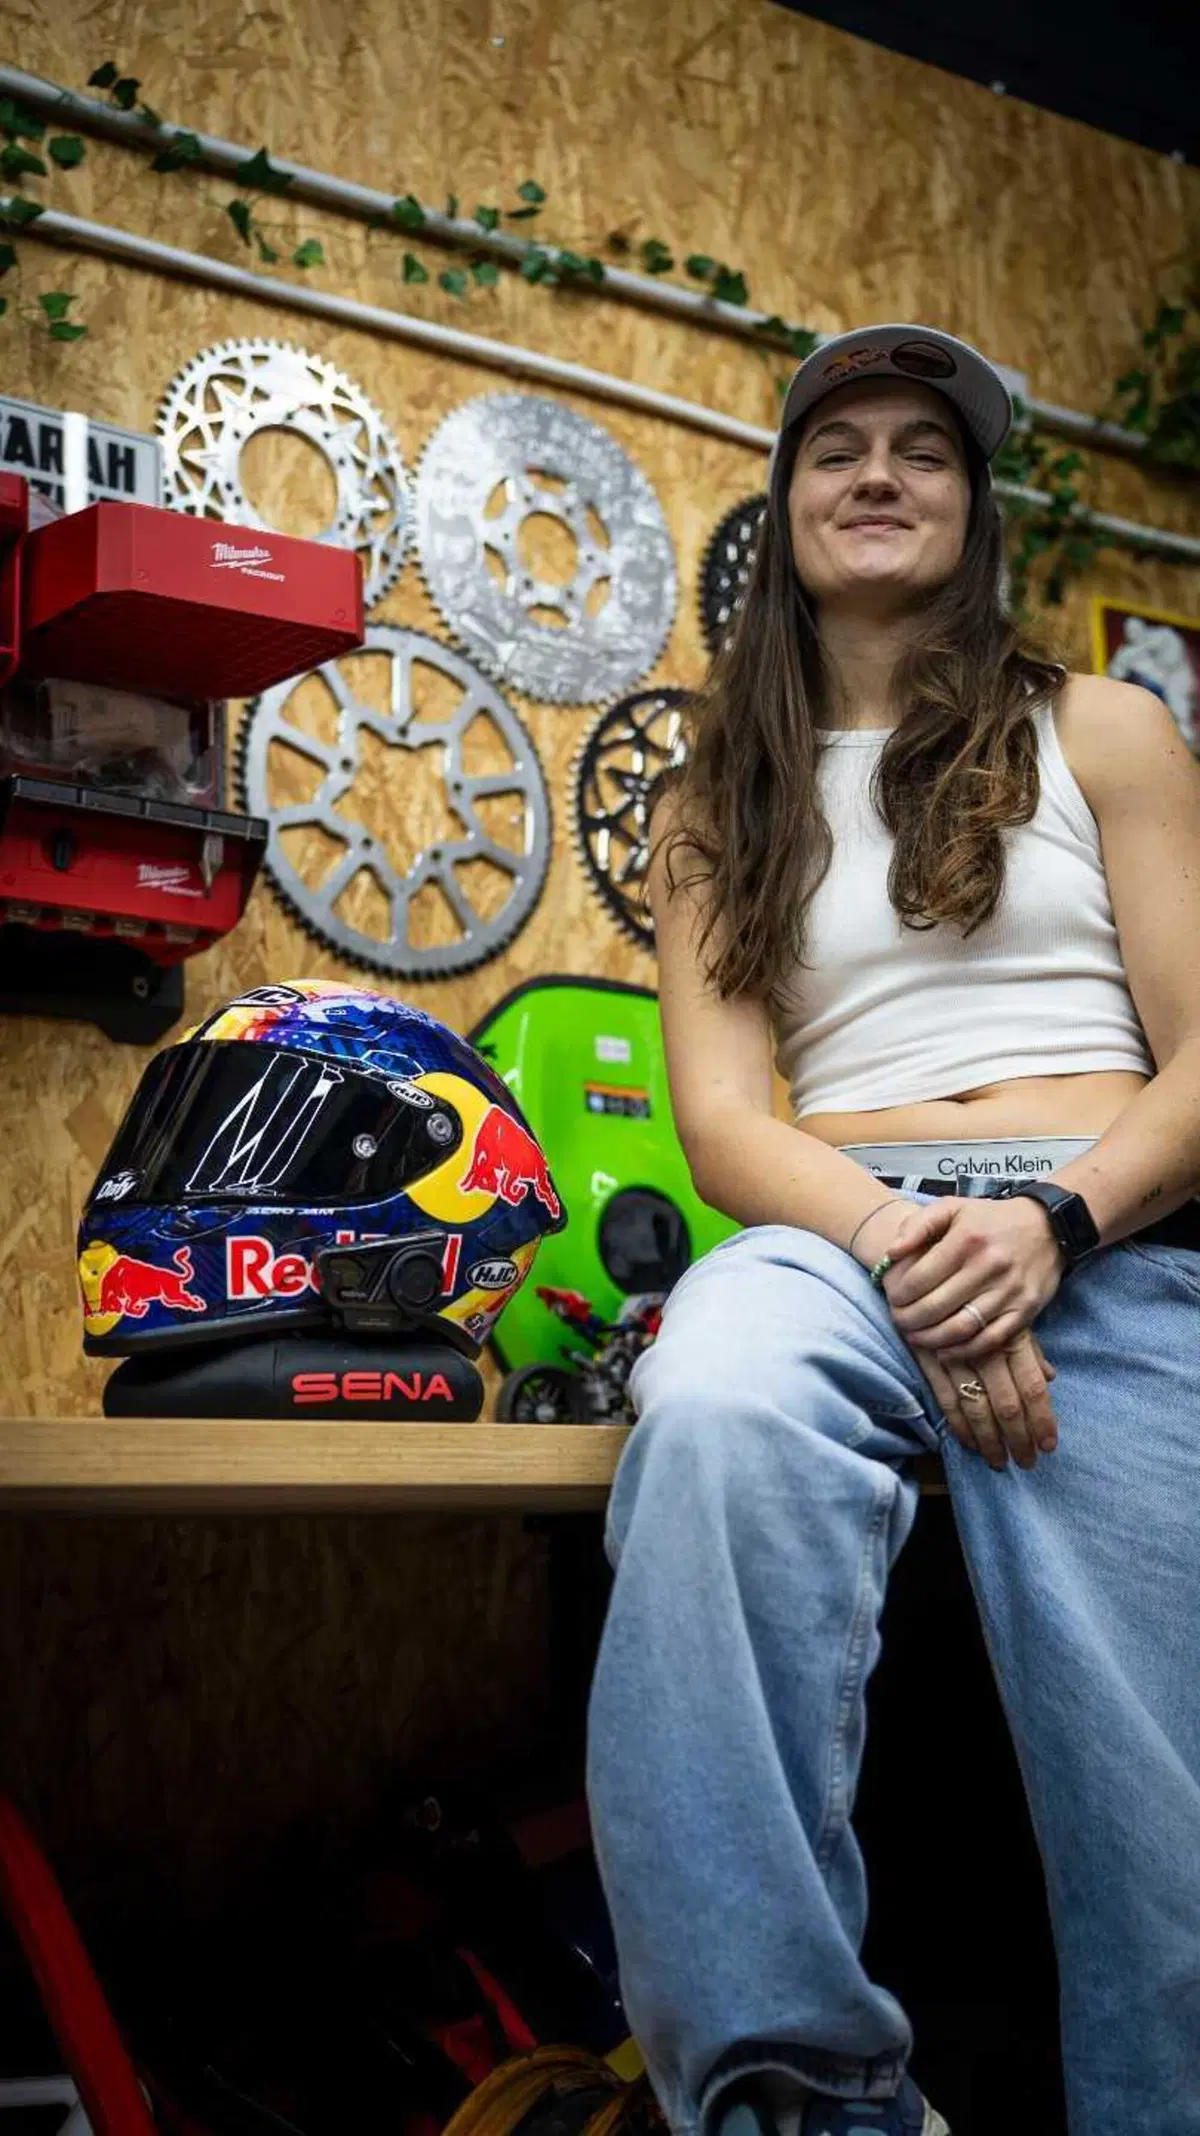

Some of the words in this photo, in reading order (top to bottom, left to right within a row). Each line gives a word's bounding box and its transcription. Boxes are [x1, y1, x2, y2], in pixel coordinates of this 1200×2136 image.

[0, 411, 136, 495] ARAH
[390, 1083, 431, 1107] HJC
[937, 1156, 1001, 1176] Calvin
[1004, 1154, 1053, 1173] Klein
[475, 1265, 515, 1283] HJC
[291, 1371, 455, 1405] SENA
